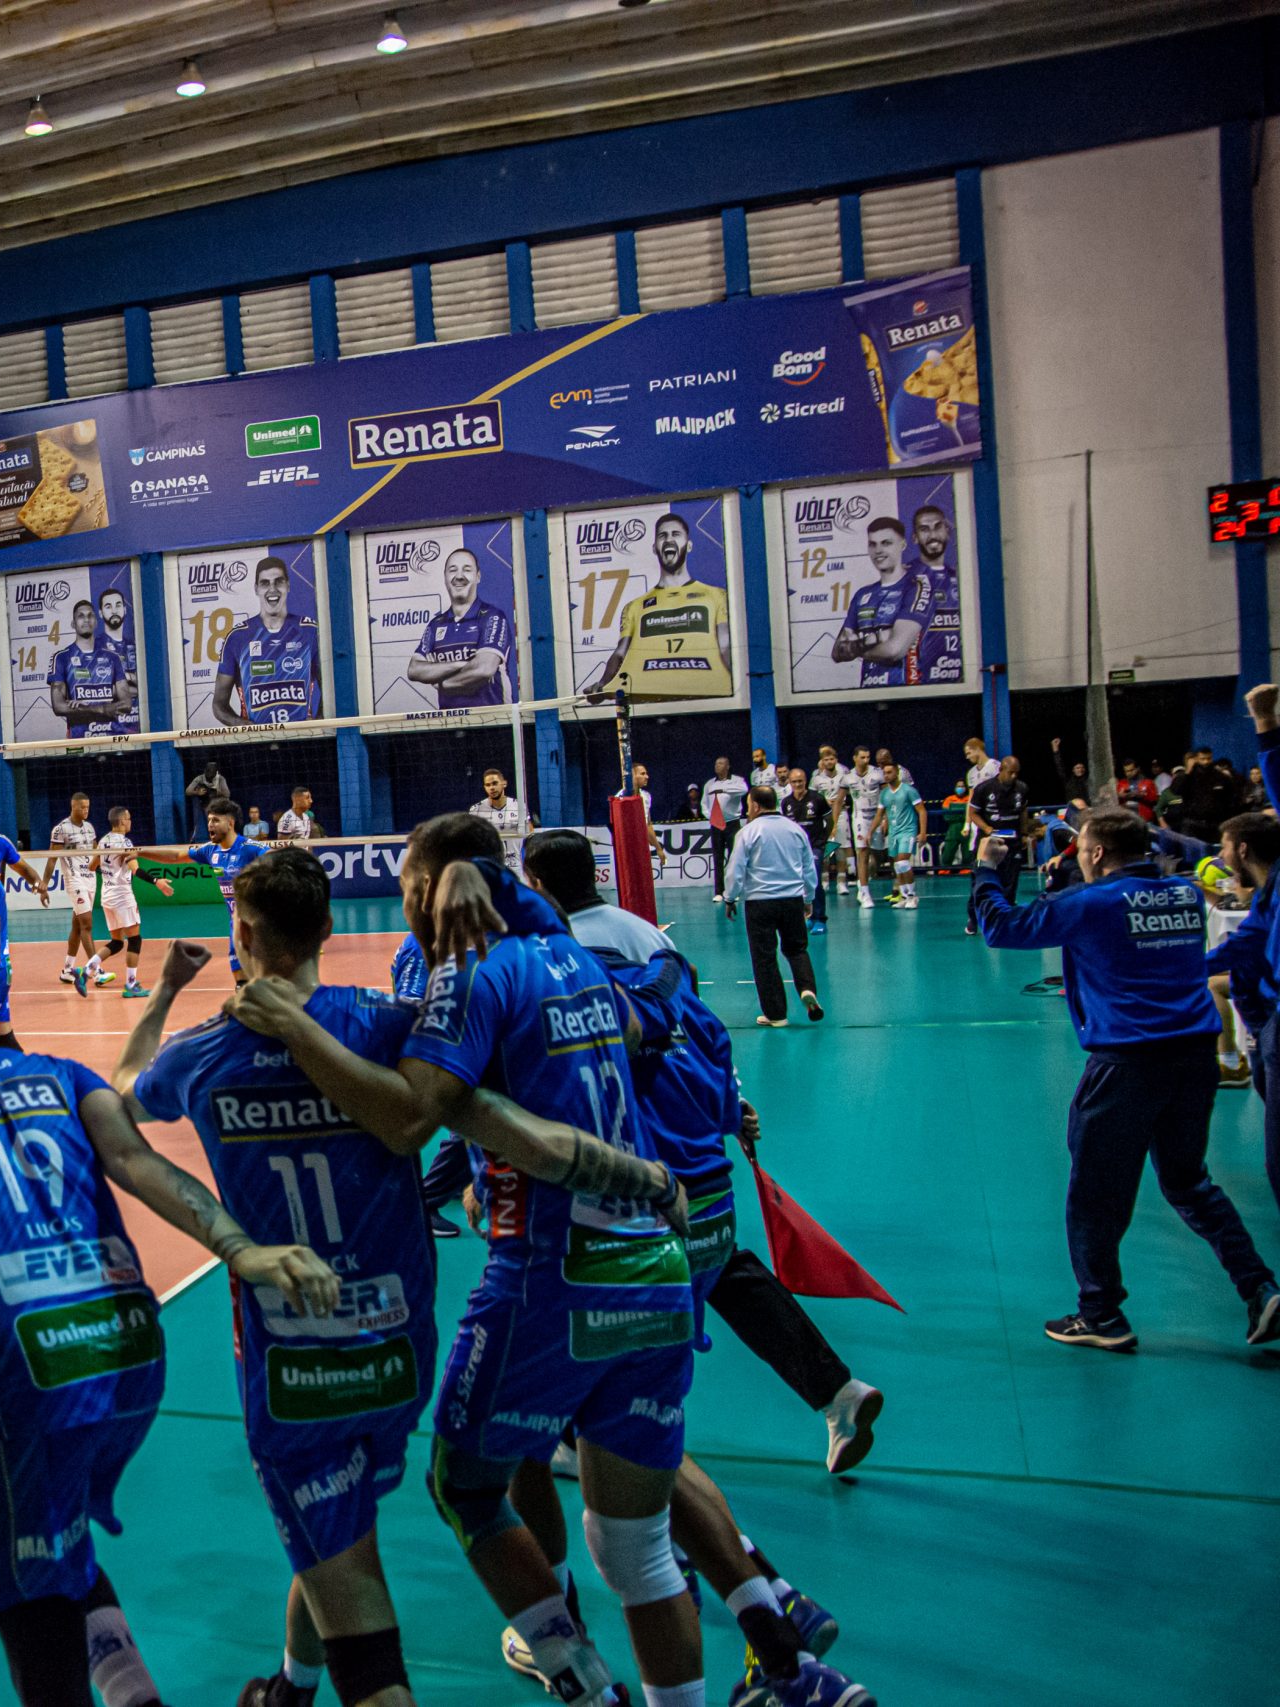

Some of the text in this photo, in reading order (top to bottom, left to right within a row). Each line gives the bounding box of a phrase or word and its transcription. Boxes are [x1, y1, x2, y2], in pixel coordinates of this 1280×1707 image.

[888, 314, 962, 346] Renata
[780, 347, 826, 366] Good
[772, 362, 813, 378] Bom
[649, 369, 736, 392] PATRIANI
[784, 397, 845, 419] Sicredi
[656, 408, 736, 435] MAJIPACK
[253, 426, 296, 441] Unimed
[355, 412, 497, 459] Renata
[566, 438, 620, 451] PENALTY
[146, 445, 206, 462] CAMPINAS
[146, 474, 208, 491] SANASA
[259, 465, 309, 485] EVER
[132, 485, 210, 500] CAMPINAS
[799, 522, 831, 533] Renata
[581, 544, 611, 554] Renata
[380, 564, 408, 574] Renata
[800, 548, 827, 579] 12
[827, 562, 845, 572] LIMA
[192, 585, 217, 594] Renata
[830, 581, 852, 612] 11
[579, 569, 630, 630] 17
[801, 594, 829, 604] FRANCK
[382, 609, 430, 627] HORÁCIO
[646, 613, 687, 625] Unimed
[48, 620, 60, 646] 4
[189, 607, 234, 664] 18
[666, 638, 685, 653] 17
[945, 636, 958, 651] 12
[17, 645, 37, 672] 14
[646, 660, 707, 670] Renata
[192, 669, 211, 677] ROQUE
[930, 667, 959, 679] Bom
[77, 687, 113, 698] Renata
[251, 685, 305, 705] Renata
[269, 709, 289, 724] 18
[406, 709, 470, 720] MASTER REDE
[180, 723, 285, 737] CAMPEONATO PAULISTA
[1127, 910, 1201, 934] Renata
[269, 1152, 343, 1245] 11
[358, 1310, 406, 1327] EXPRESS
[36, 1313, 123, 1348] Unimed
[456, 1323, 488, 1397] Sicredi
[282, 1363, 376, 1386] Unimed
[293, 1443, 368, 1511] MAJIPACK
